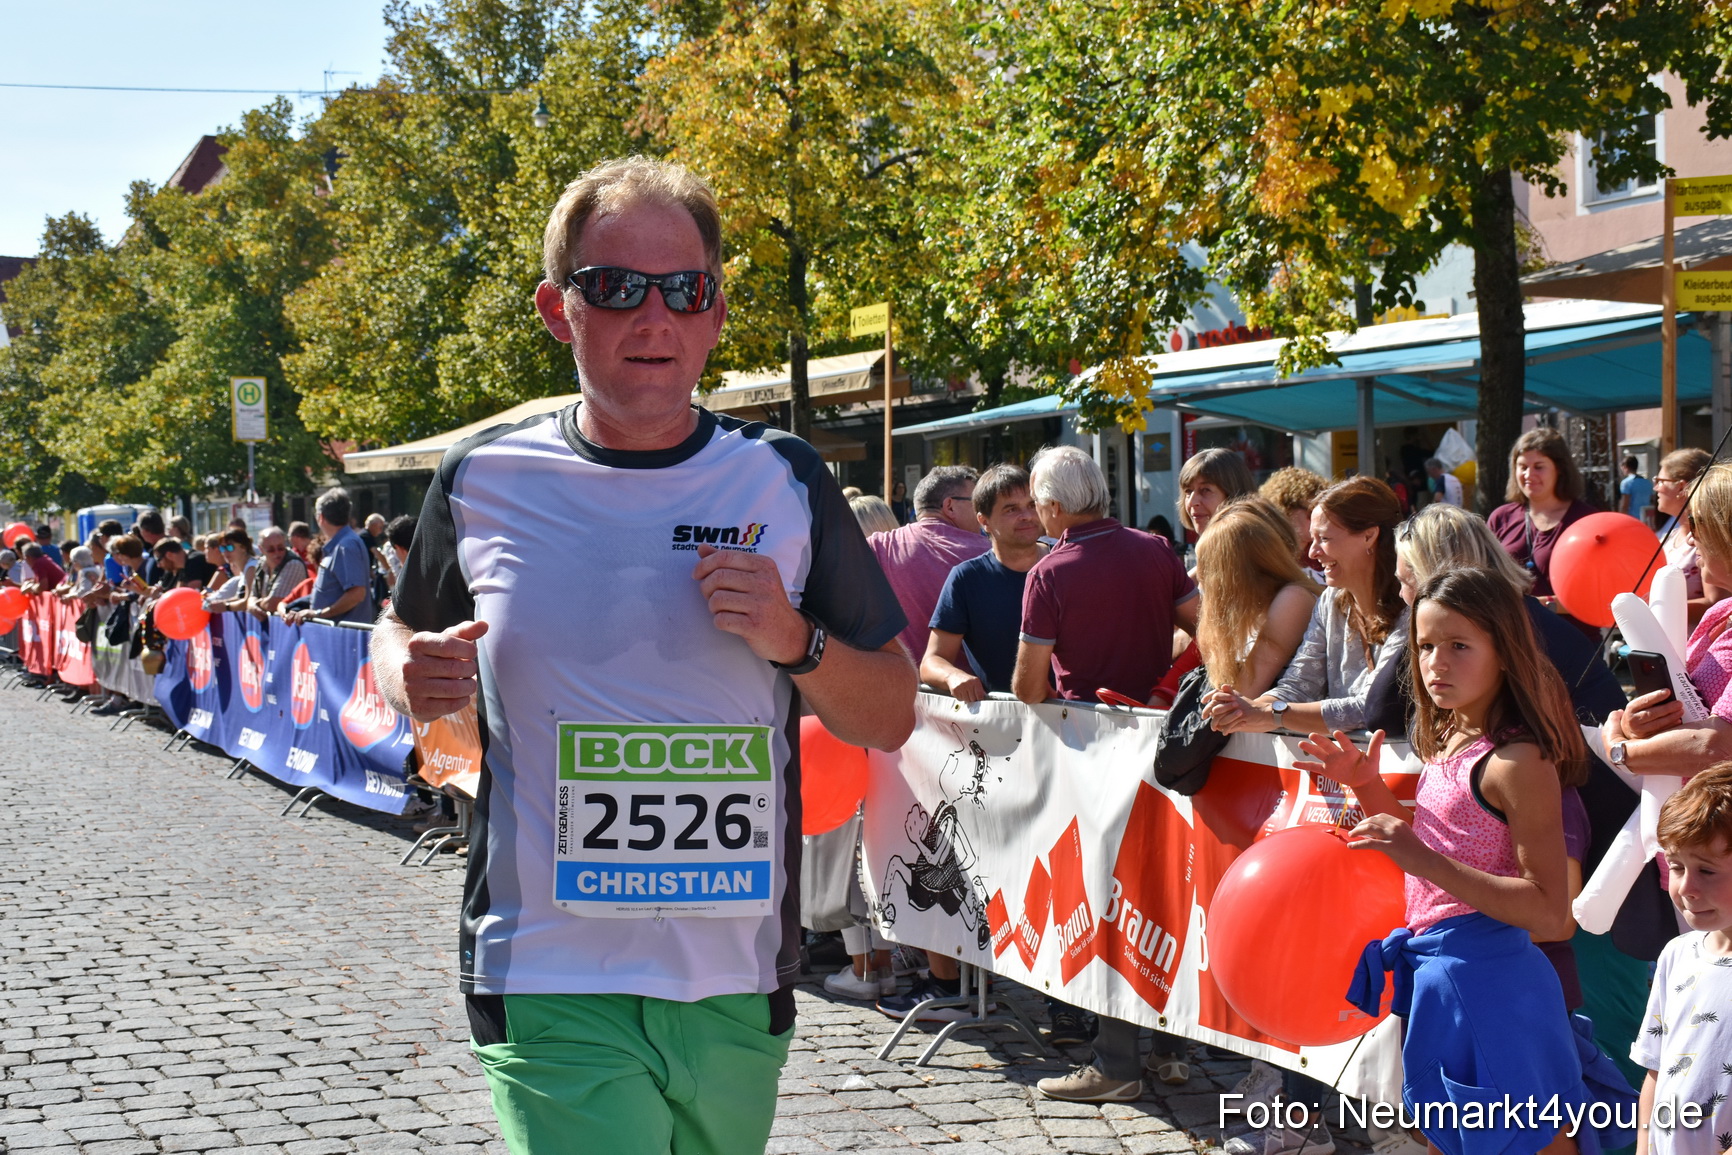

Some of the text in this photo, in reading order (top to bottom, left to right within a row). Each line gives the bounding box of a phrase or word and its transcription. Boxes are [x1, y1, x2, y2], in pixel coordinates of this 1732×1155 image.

[1675, 184, 1732, 196] tartnummern
[1684, 198, 1722, 213] ausgabe
[858, 314, 886, 327] Toiletten
[243, 387, 255, 401] H
[672, 525, 740, 545] swn
[1676, 672, 1702, 711] stadtwerke
[577, 735, 755, 771] BOCK
[757, 798, 766, 808] C
[583, 793, 751, 851] 2526
[1185, 843, 1196, 883] Seit 1929
[576, 870, 753, 895] CHRISTIAN
[1053, 901, 1091, 957] Braun
[1099, 876, 1178, 974] Braun
[1124, 945, 1141, 969] Sicher
[1139, 963, 1151, 978] ist
